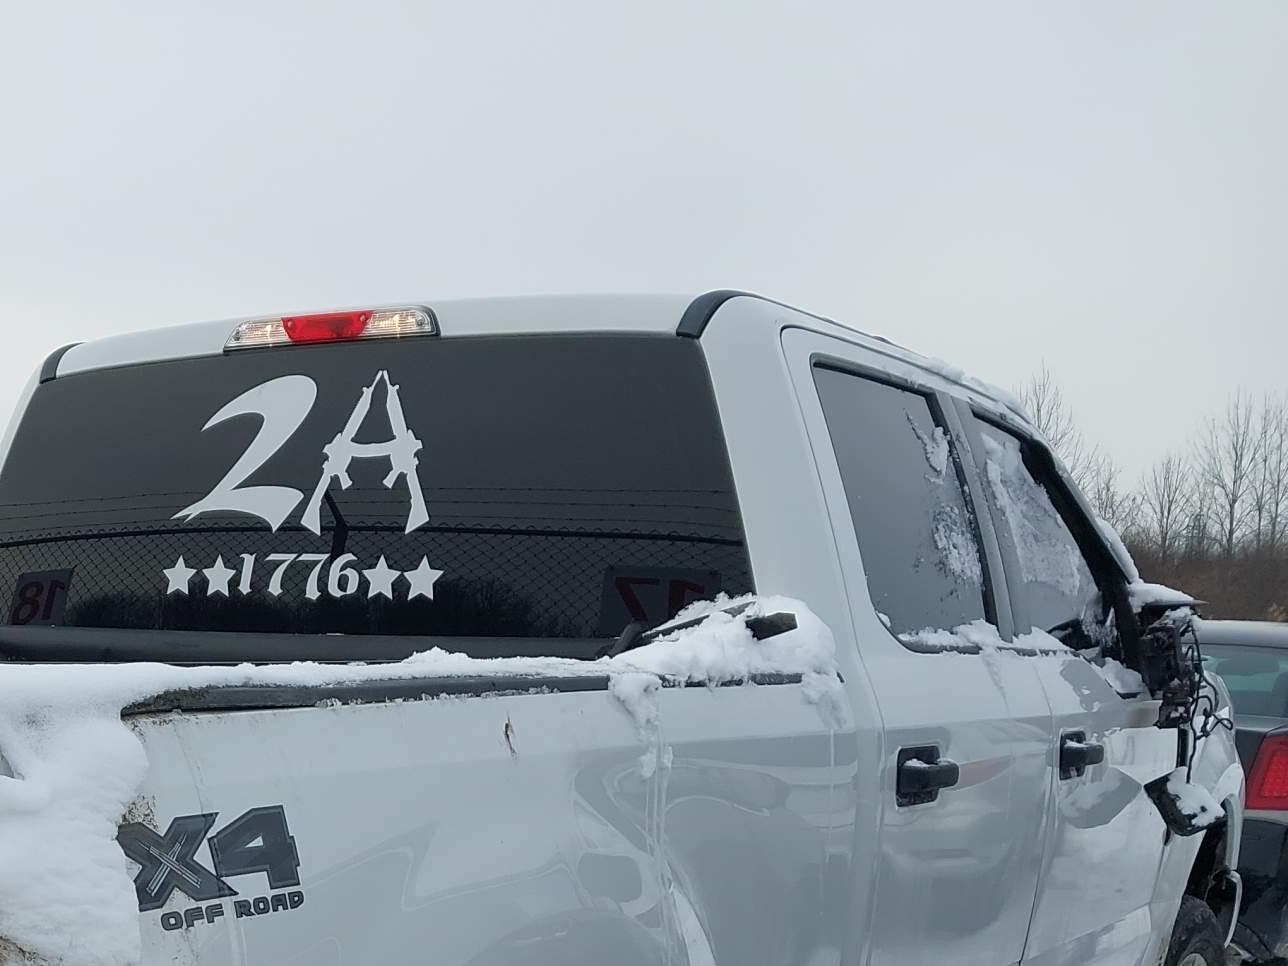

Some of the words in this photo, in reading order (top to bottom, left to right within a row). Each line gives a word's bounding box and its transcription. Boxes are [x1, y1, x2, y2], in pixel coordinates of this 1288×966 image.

[172, 369, 430, 535] 2A
[237, 552, 361, 599] 1776
[161, 903, 224, 932] OFF
[234, 891, 305, 918] ROAD
